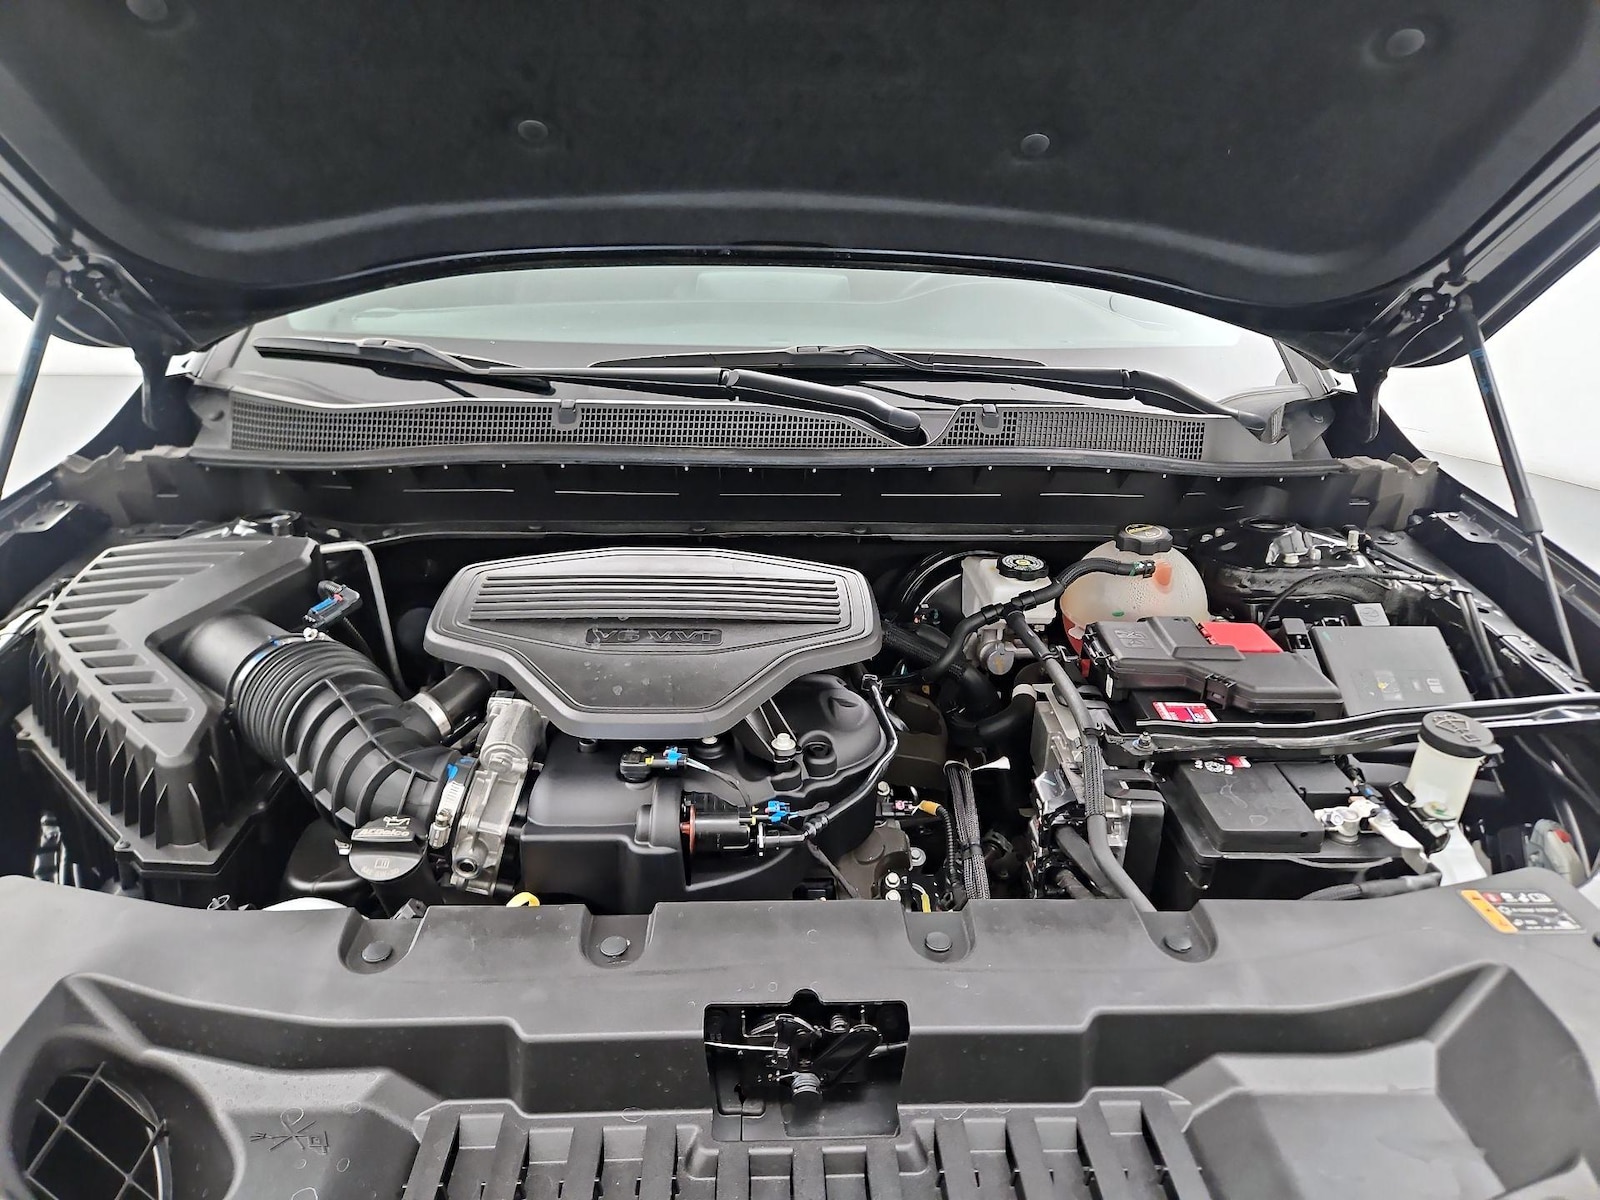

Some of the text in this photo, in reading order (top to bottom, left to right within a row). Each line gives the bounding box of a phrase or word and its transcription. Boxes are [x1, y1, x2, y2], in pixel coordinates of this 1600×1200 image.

[592, 629, 721, 642] V6 VVT
[356, 828, 410, 837] ACDelco
